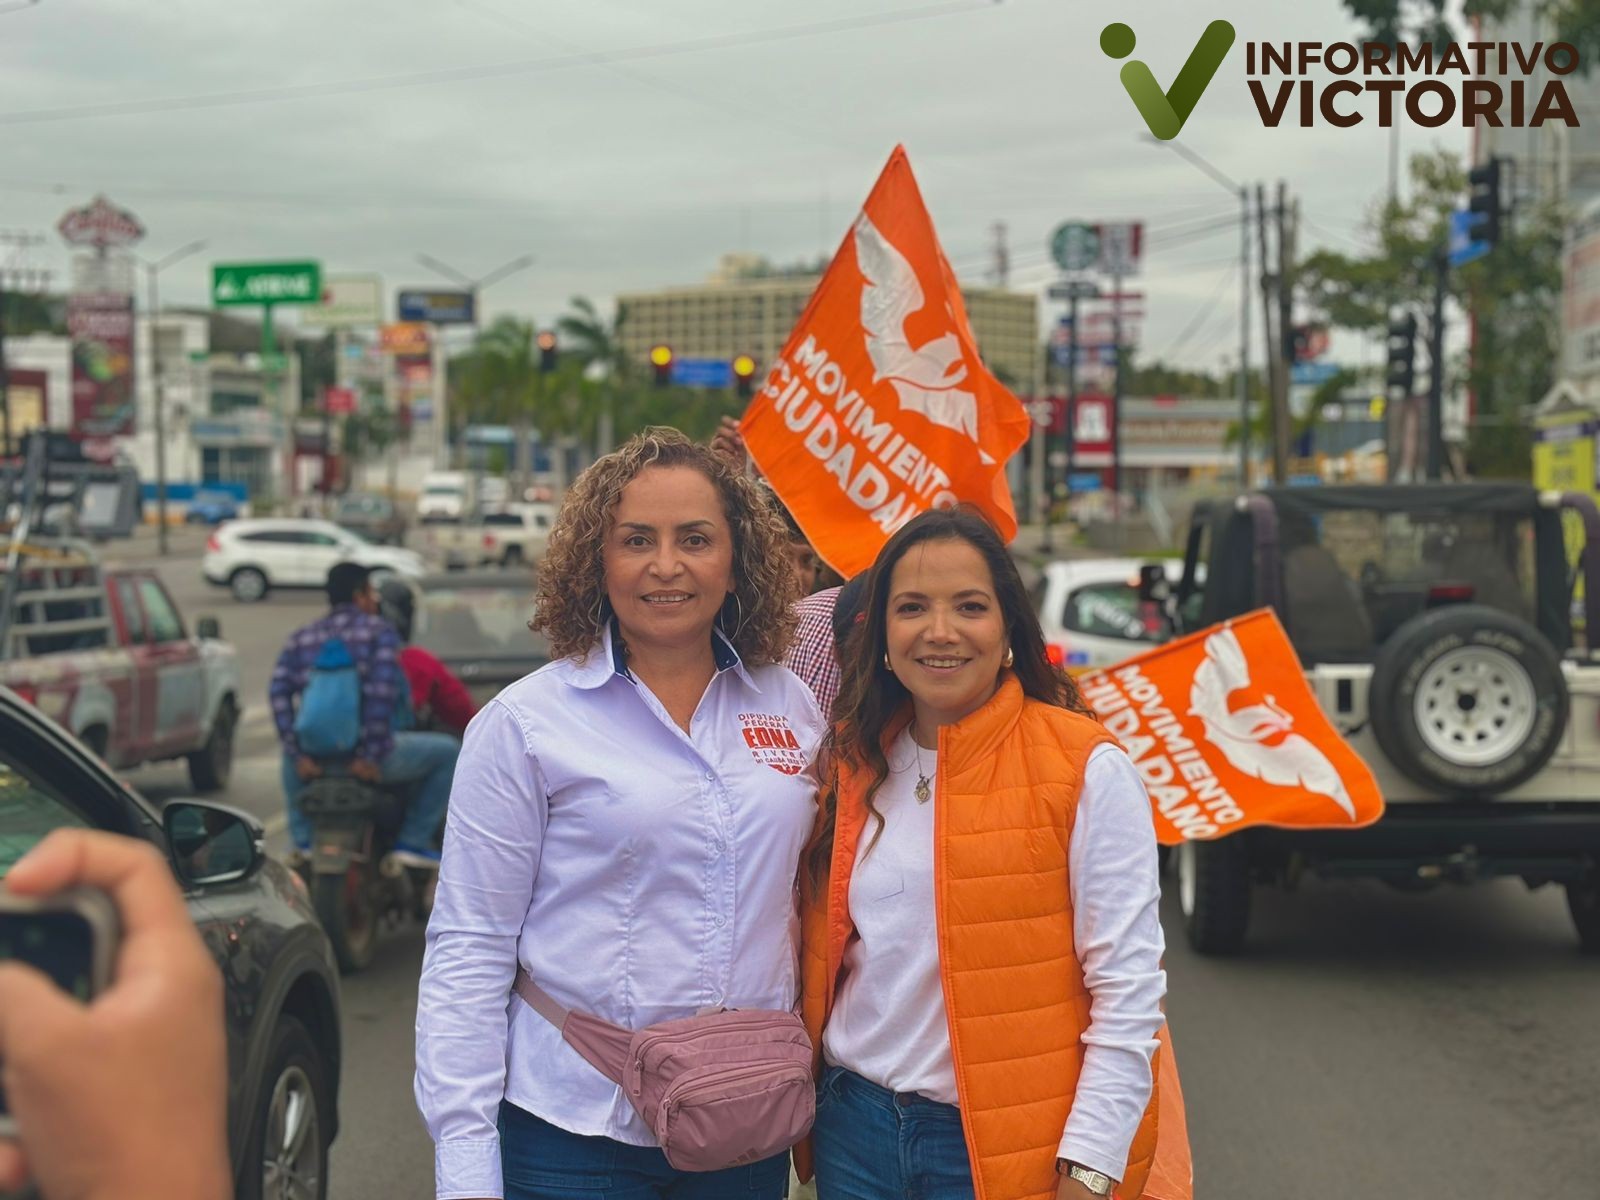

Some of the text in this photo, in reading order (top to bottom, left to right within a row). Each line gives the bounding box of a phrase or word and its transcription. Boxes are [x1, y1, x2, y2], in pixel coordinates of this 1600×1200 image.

[738, 713, 788, 722] DIPUTADA
[745, 720, 788, 728] FEDERAL
[742, 727, 801, 749] EDNA
[1113, 664, 1245, 824] MOVIMIENTO
[752, 750, 805, 760] RIVERA
[1078, 669, 1219, 840] CIUDADANO
